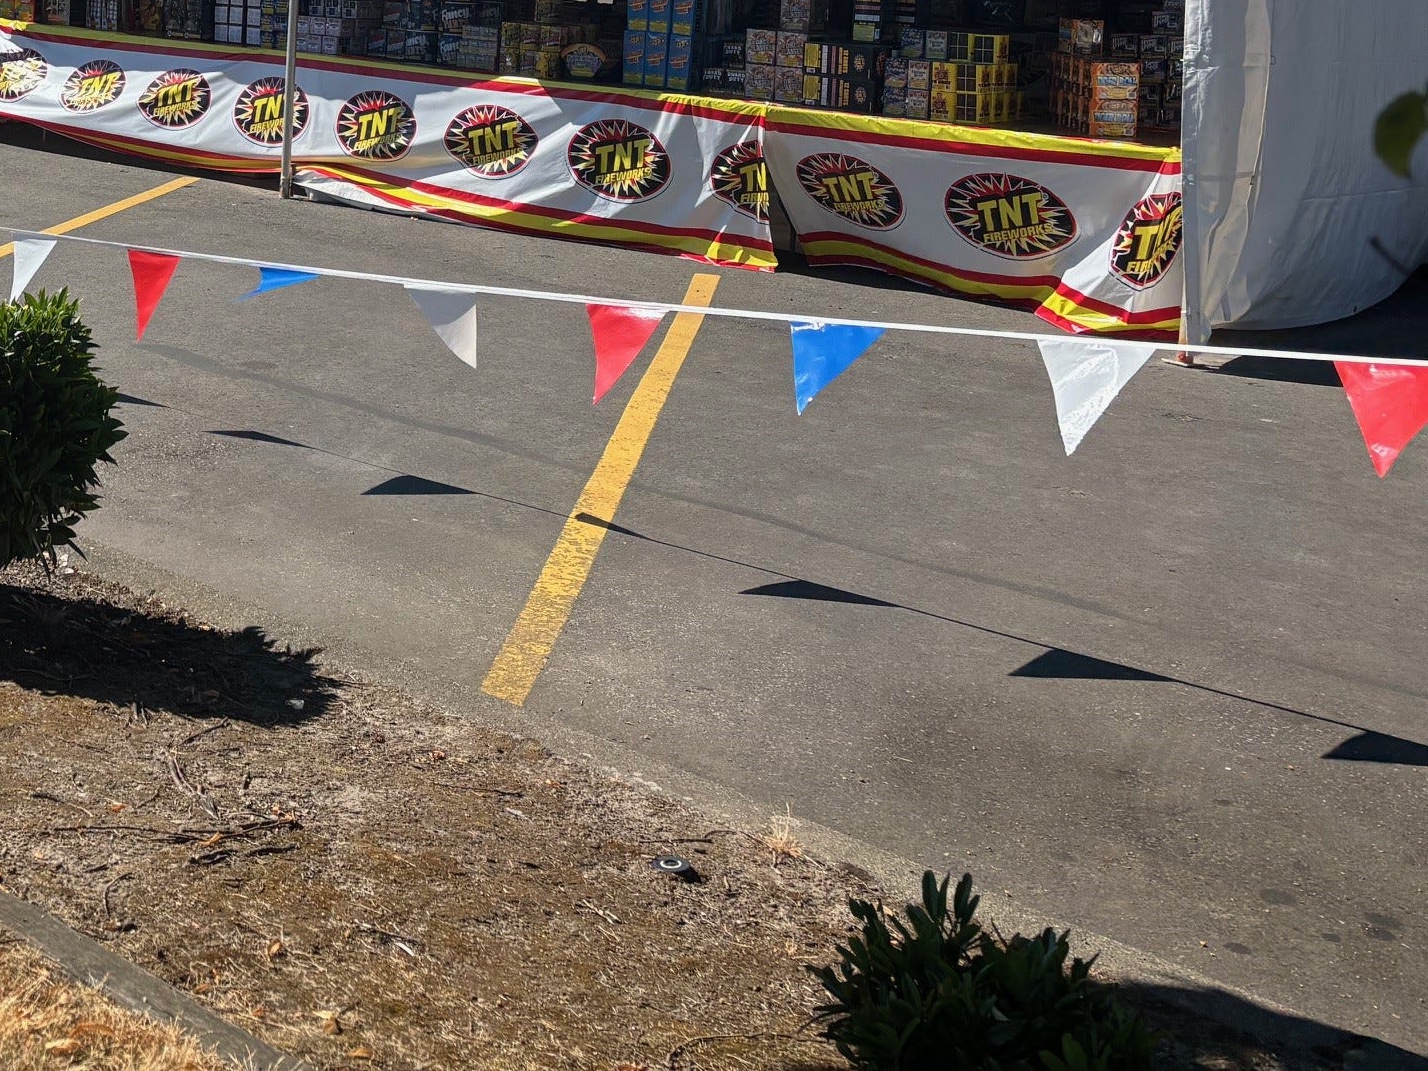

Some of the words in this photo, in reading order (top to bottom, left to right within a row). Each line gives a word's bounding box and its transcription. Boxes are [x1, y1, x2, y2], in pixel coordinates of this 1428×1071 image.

[79, 71, 122, 96] TNT
[157, 79, 197, 107] TNT
[153, 100, 198, 116] FIREWORKS
[254, 94, 285, 123] TN
[359, 106, 403, 140] TNT
[354, 133, 402, 151] FIREWORKS
[468, 120, 519, 156] TNT
[473, 147, 523, 167] FIREWORKS
[595, 138, 650, 173] TNT
[595, 167, 652, 185] FIREWORKS
[740, 162, 767, 192] TN
[822, 171, 874, 202] TNT
[833, 199, 885, 212] FIREWORKS
[977, 192, 1042, 232] TNT
[983, 222, 1054, 243] FIREWORKS
